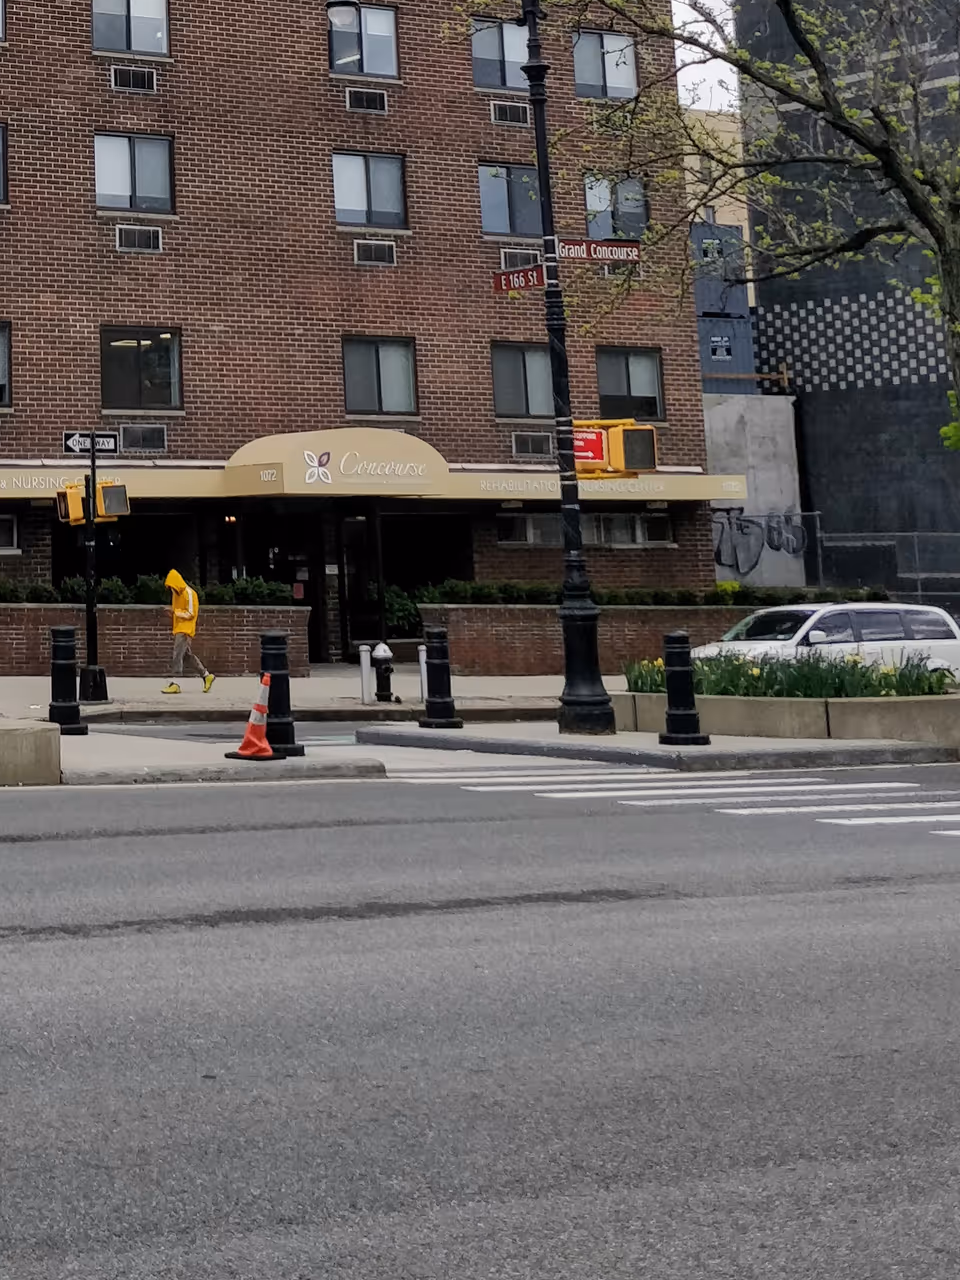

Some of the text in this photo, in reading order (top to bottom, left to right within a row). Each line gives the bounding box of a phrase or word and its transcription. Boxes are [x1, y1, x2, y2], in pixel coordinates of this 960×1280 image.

[558, 242, 640, 261] Grand Concourse
[501, 270, 538, 290] E 166 St
[72, 438, 111, 448] ONE WAY
[339, 451, 427, 477] Concourse
[0, 479, 7, 490] &
[12, 476, 69, 489] NURSING
[260, 469, 277, 482] 1072
